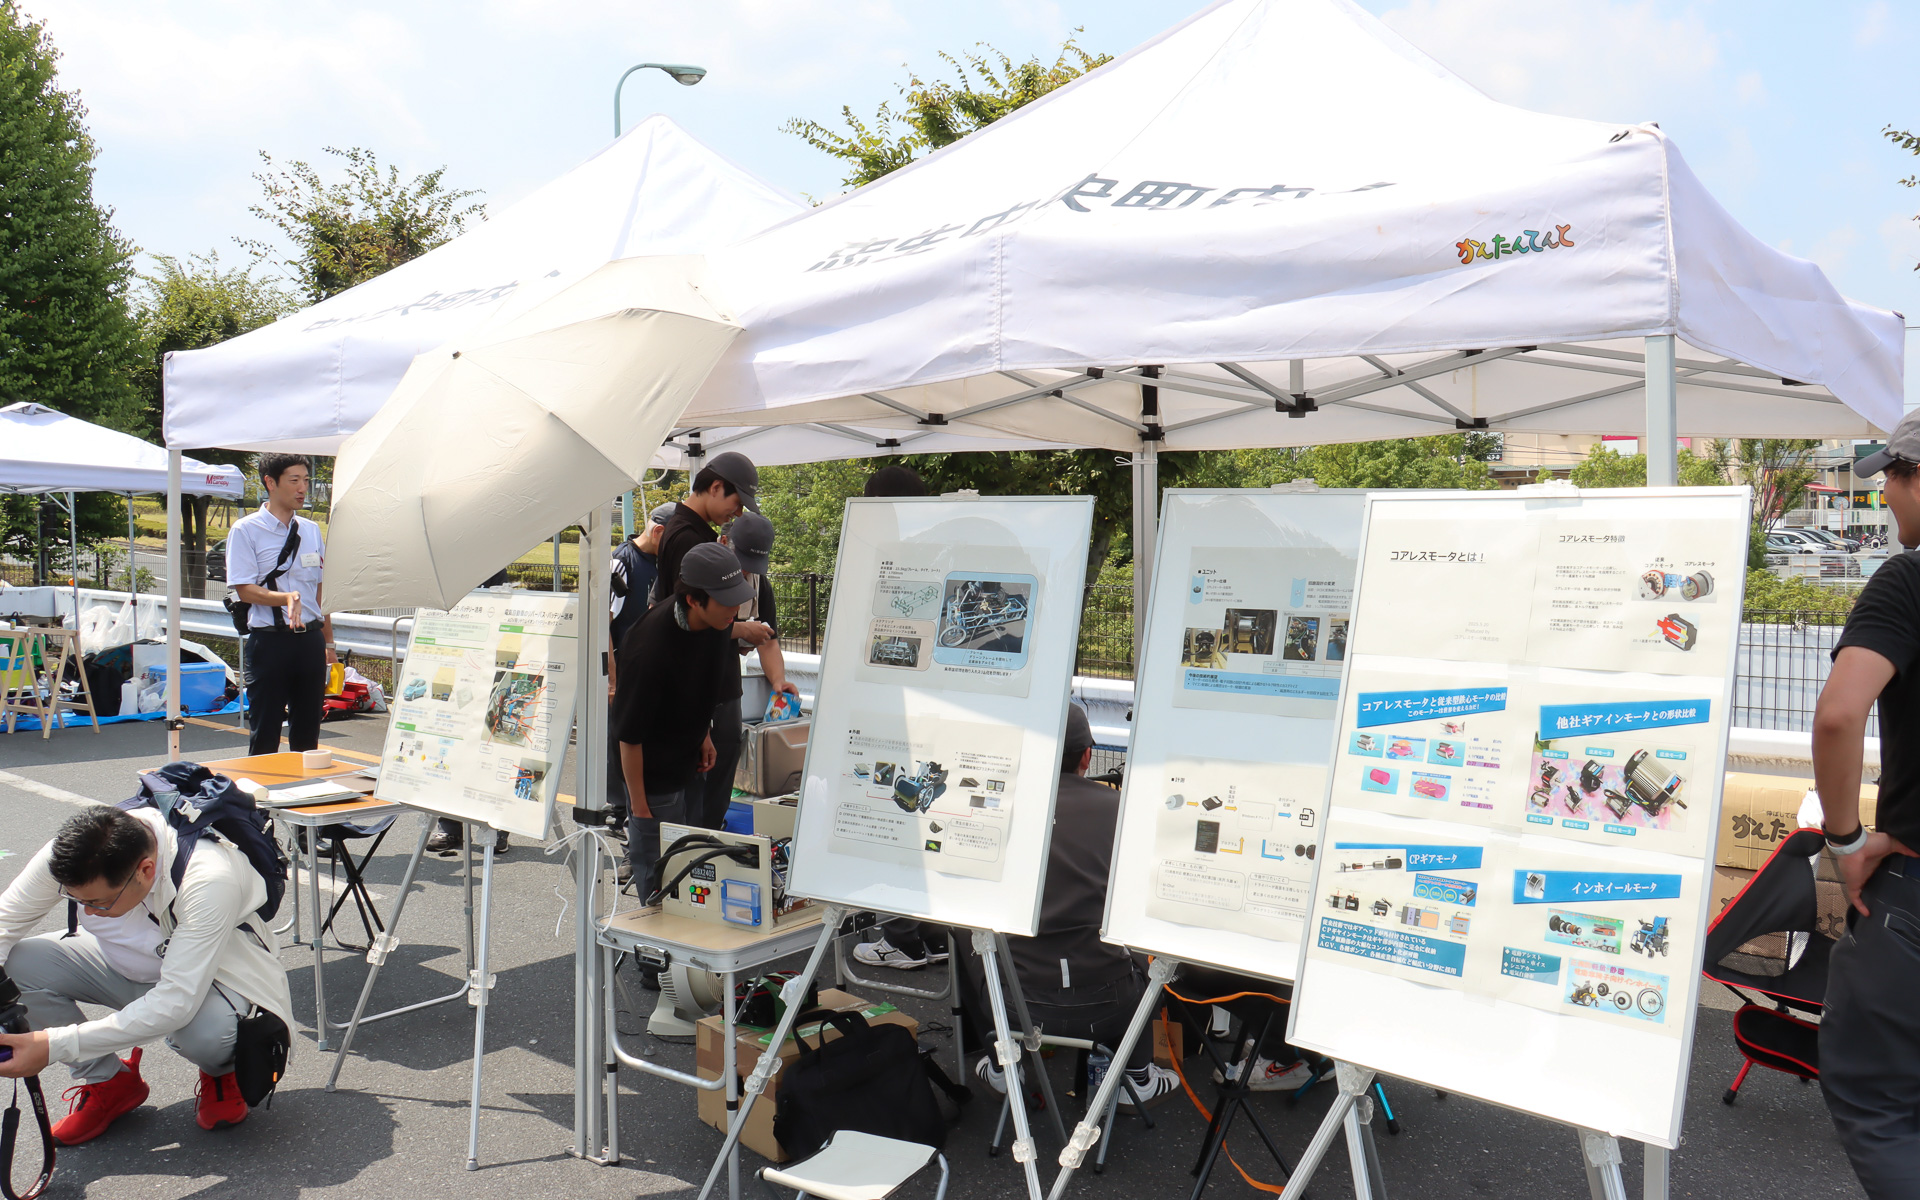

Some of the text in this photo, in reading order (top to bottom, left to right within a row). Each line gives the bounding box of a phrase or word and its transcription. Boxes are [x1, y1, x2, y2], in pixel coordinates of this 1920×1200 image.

[1456, 224, 1574, 264] かんたんてんと
[1390, 550, 1486, 562] コアレスモータとは！
[1664, 574, 1692, 588] 軽い
[1362, 692, 1507, 712] コアレスモータと従来型鉄心モータの比較
[1556, 708, 1696, 730] 他社ギアインモータとの形状比較
[1732, 814, 1790, 842] かんた
[1409, 854, 1458, 864] CPギアモータ
[1572, 882, 1658, 894] インホイールモータ
[1510, 963, 1535, 972] シニアカー
